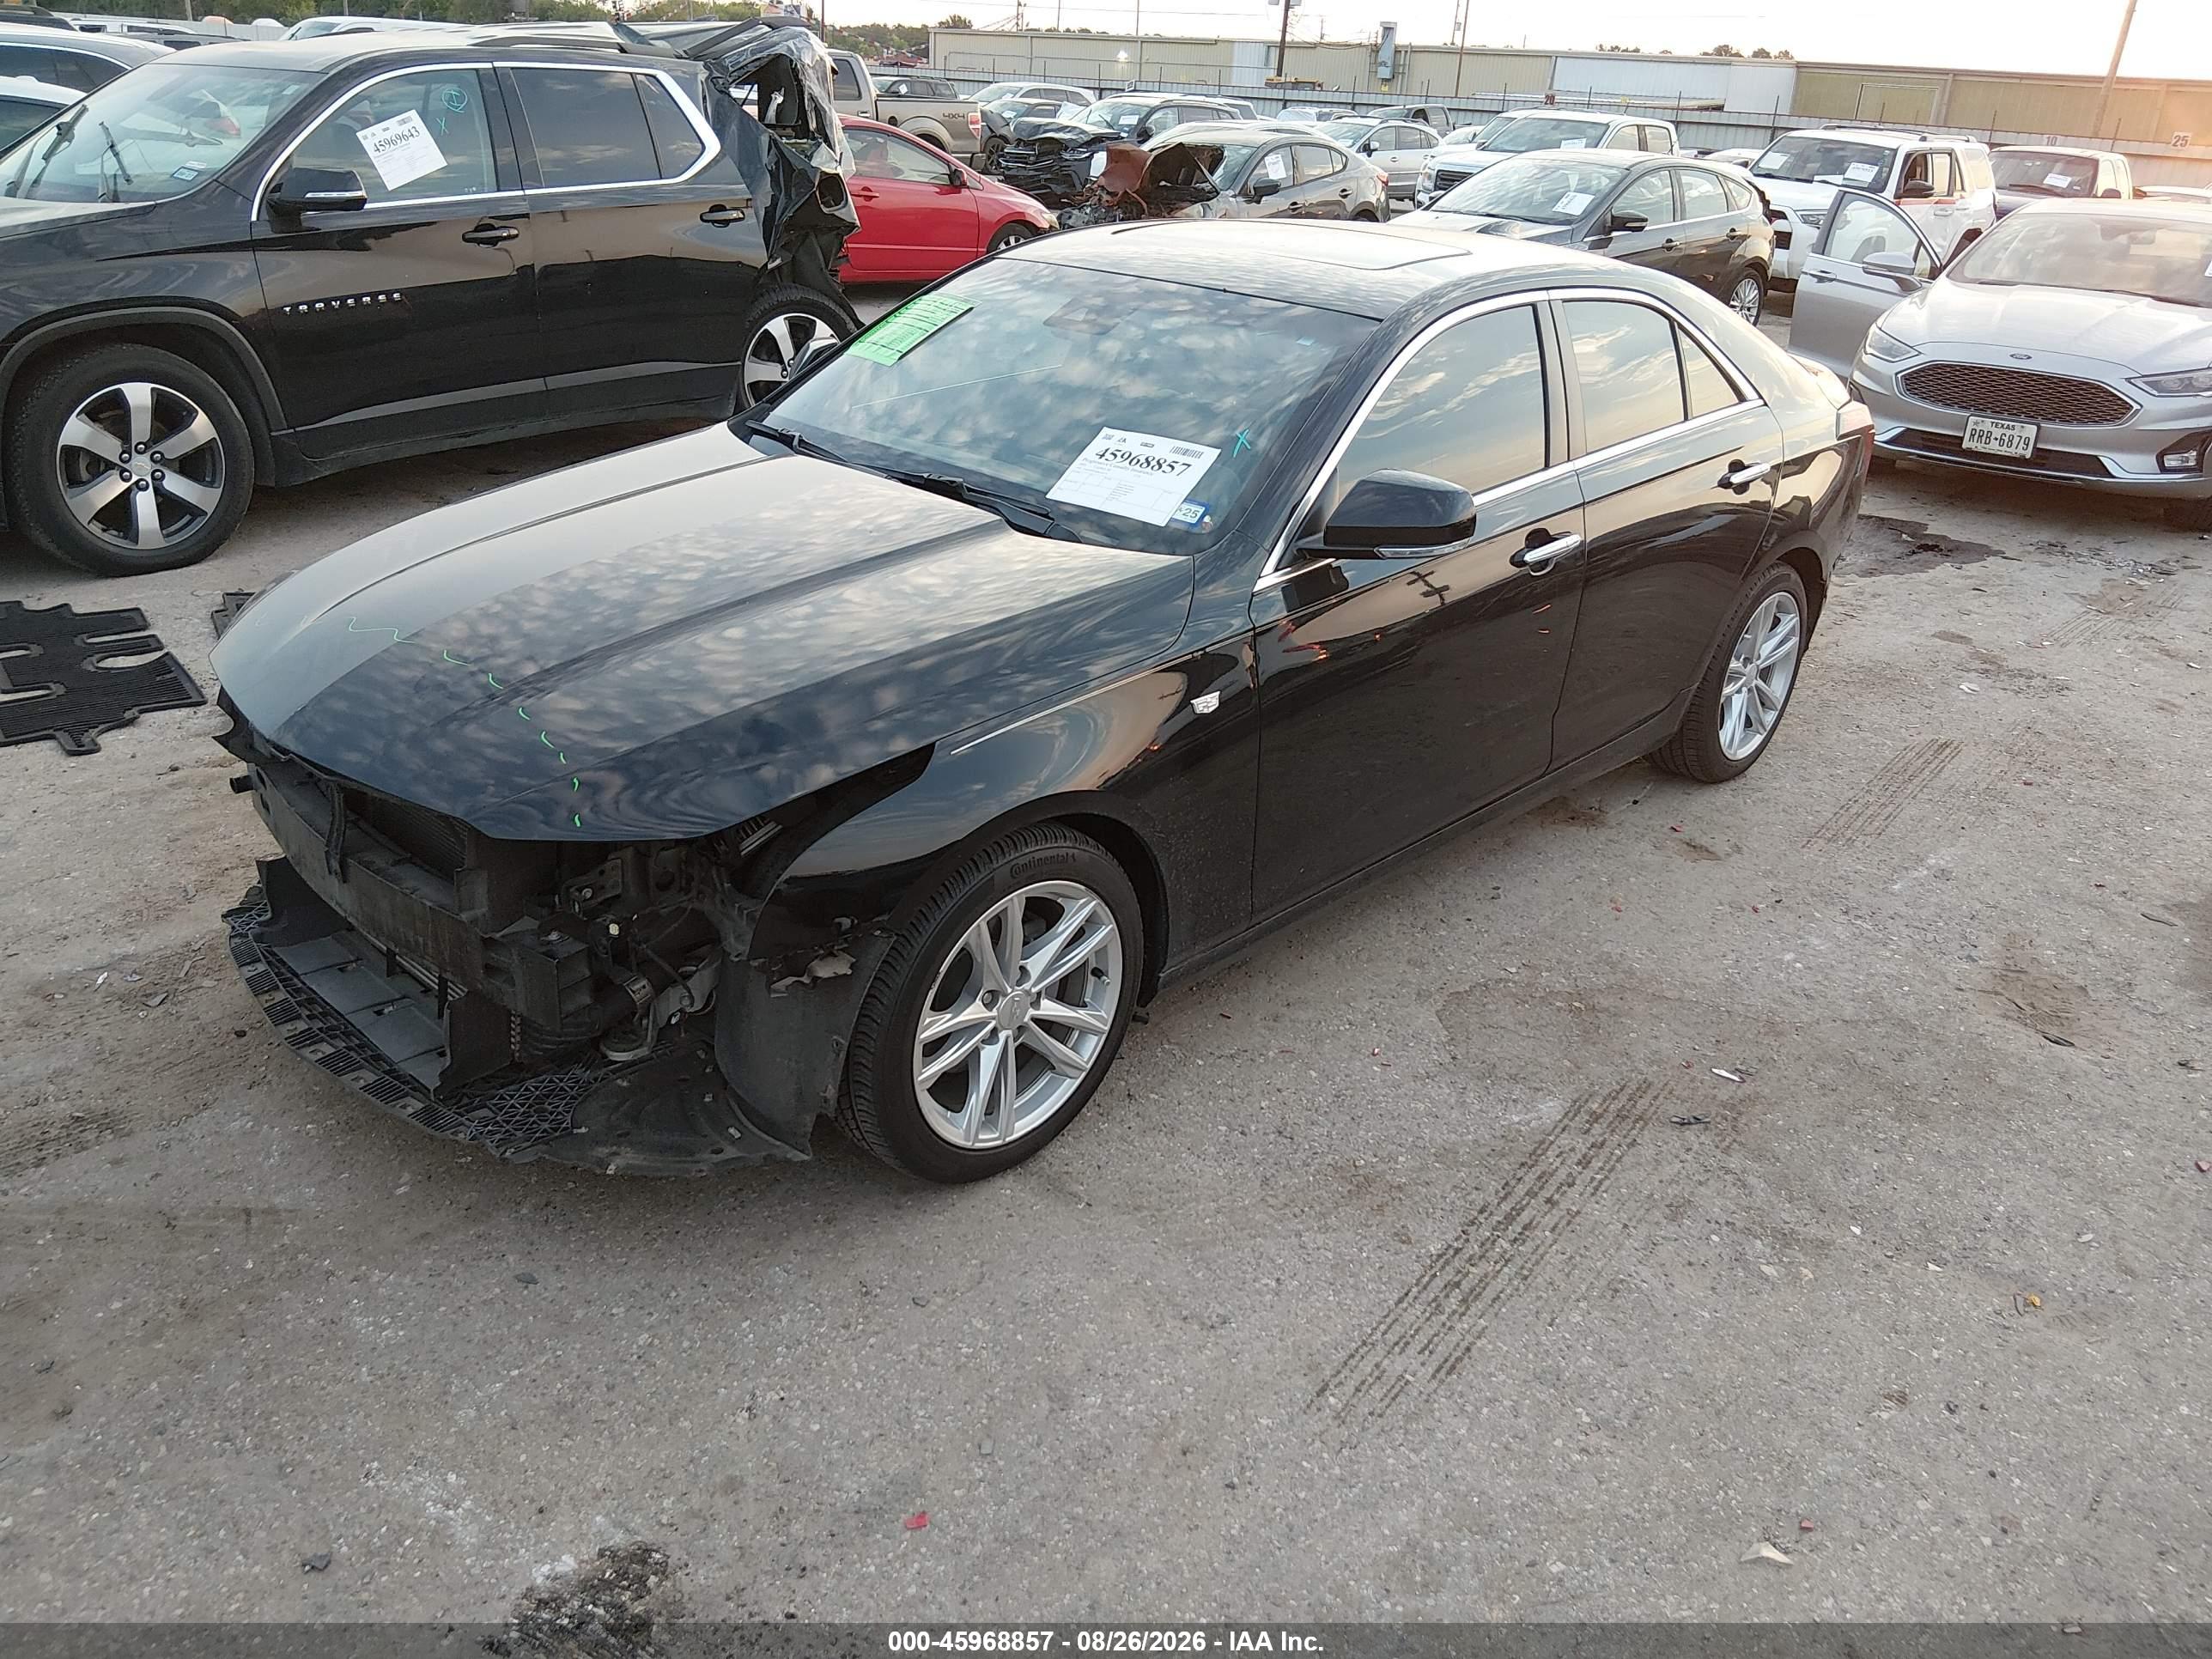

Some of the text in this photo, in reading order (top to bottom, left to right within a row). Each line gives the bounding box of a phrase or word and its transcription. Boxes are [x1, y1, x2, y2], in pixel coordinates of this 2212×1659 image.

[1544, 94, 1556, 106] 20
[373, 125, 421, 155] 45969643
[2045, 136, 2058, 147] 10
[2171, 135, 2189, 149] 25
[283, 292, 402, 315] TRAVERSE
[1990, 421, 2016, 431] TEXAS
[1095, 447, 1193, 477] 45968857
[1182, 507, 1200, 519] 25
[1010, 852, 1069, 878] Continental
